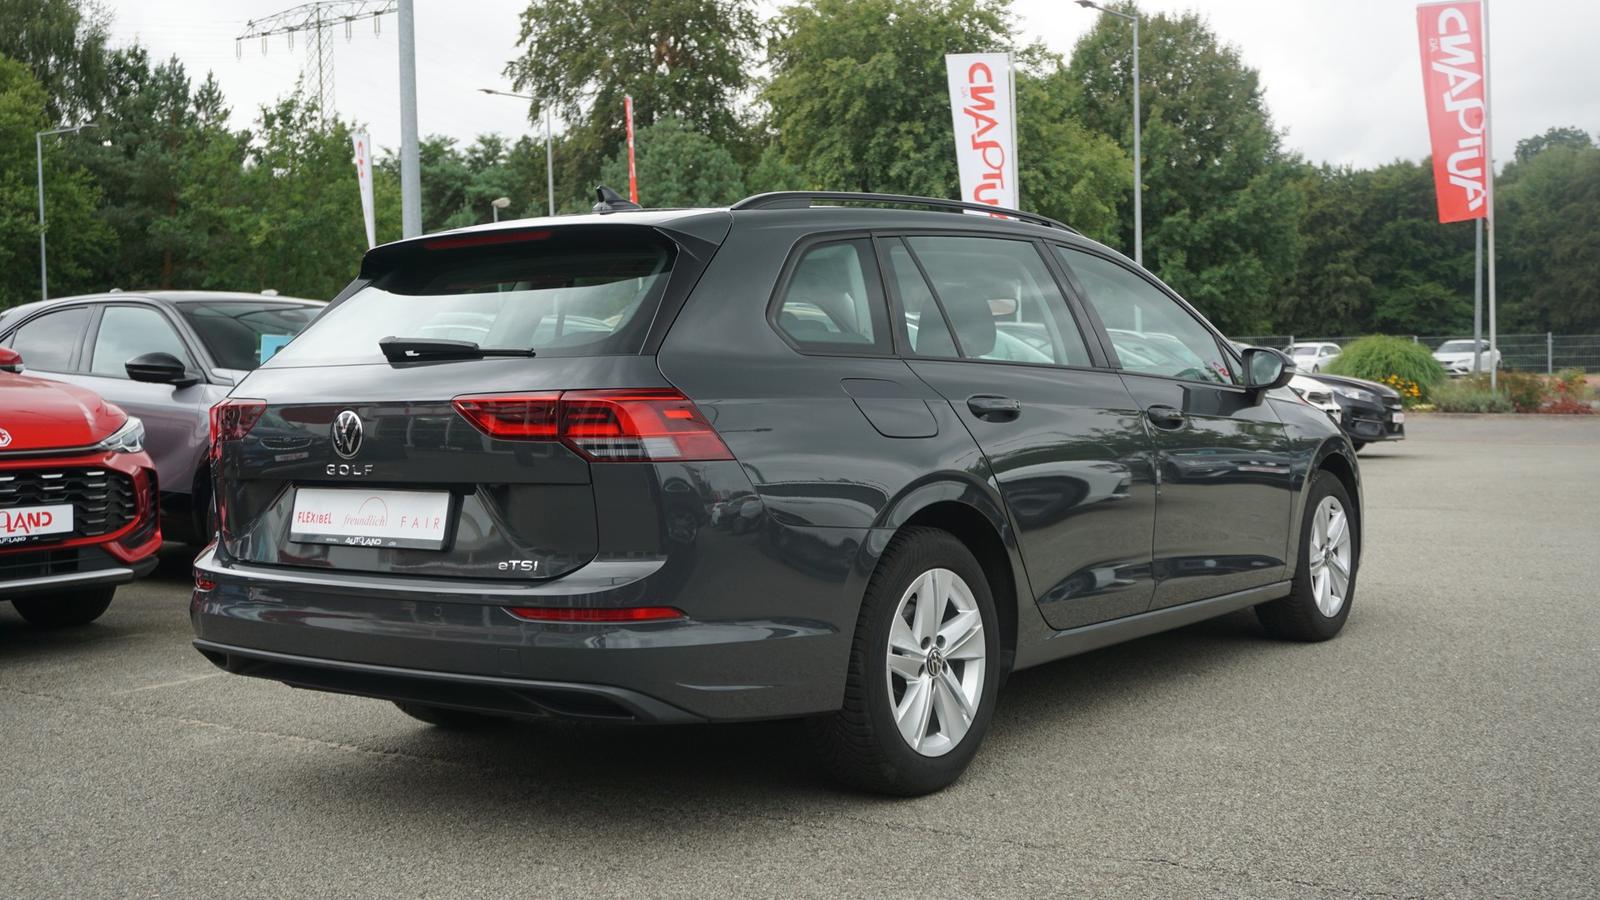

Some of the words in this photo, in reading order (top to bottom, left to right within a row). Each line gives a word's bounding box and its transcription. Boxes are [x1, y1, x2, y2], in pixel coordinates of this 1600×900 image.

[326, 464, 374, 475] GOLF
[297, 511, 332, 525] FLEXIBEL
[343, 513, 387, 527] freundlich
[400, 516, 440, 529] FAIR
[498, 560, 539, 572] eTSI
